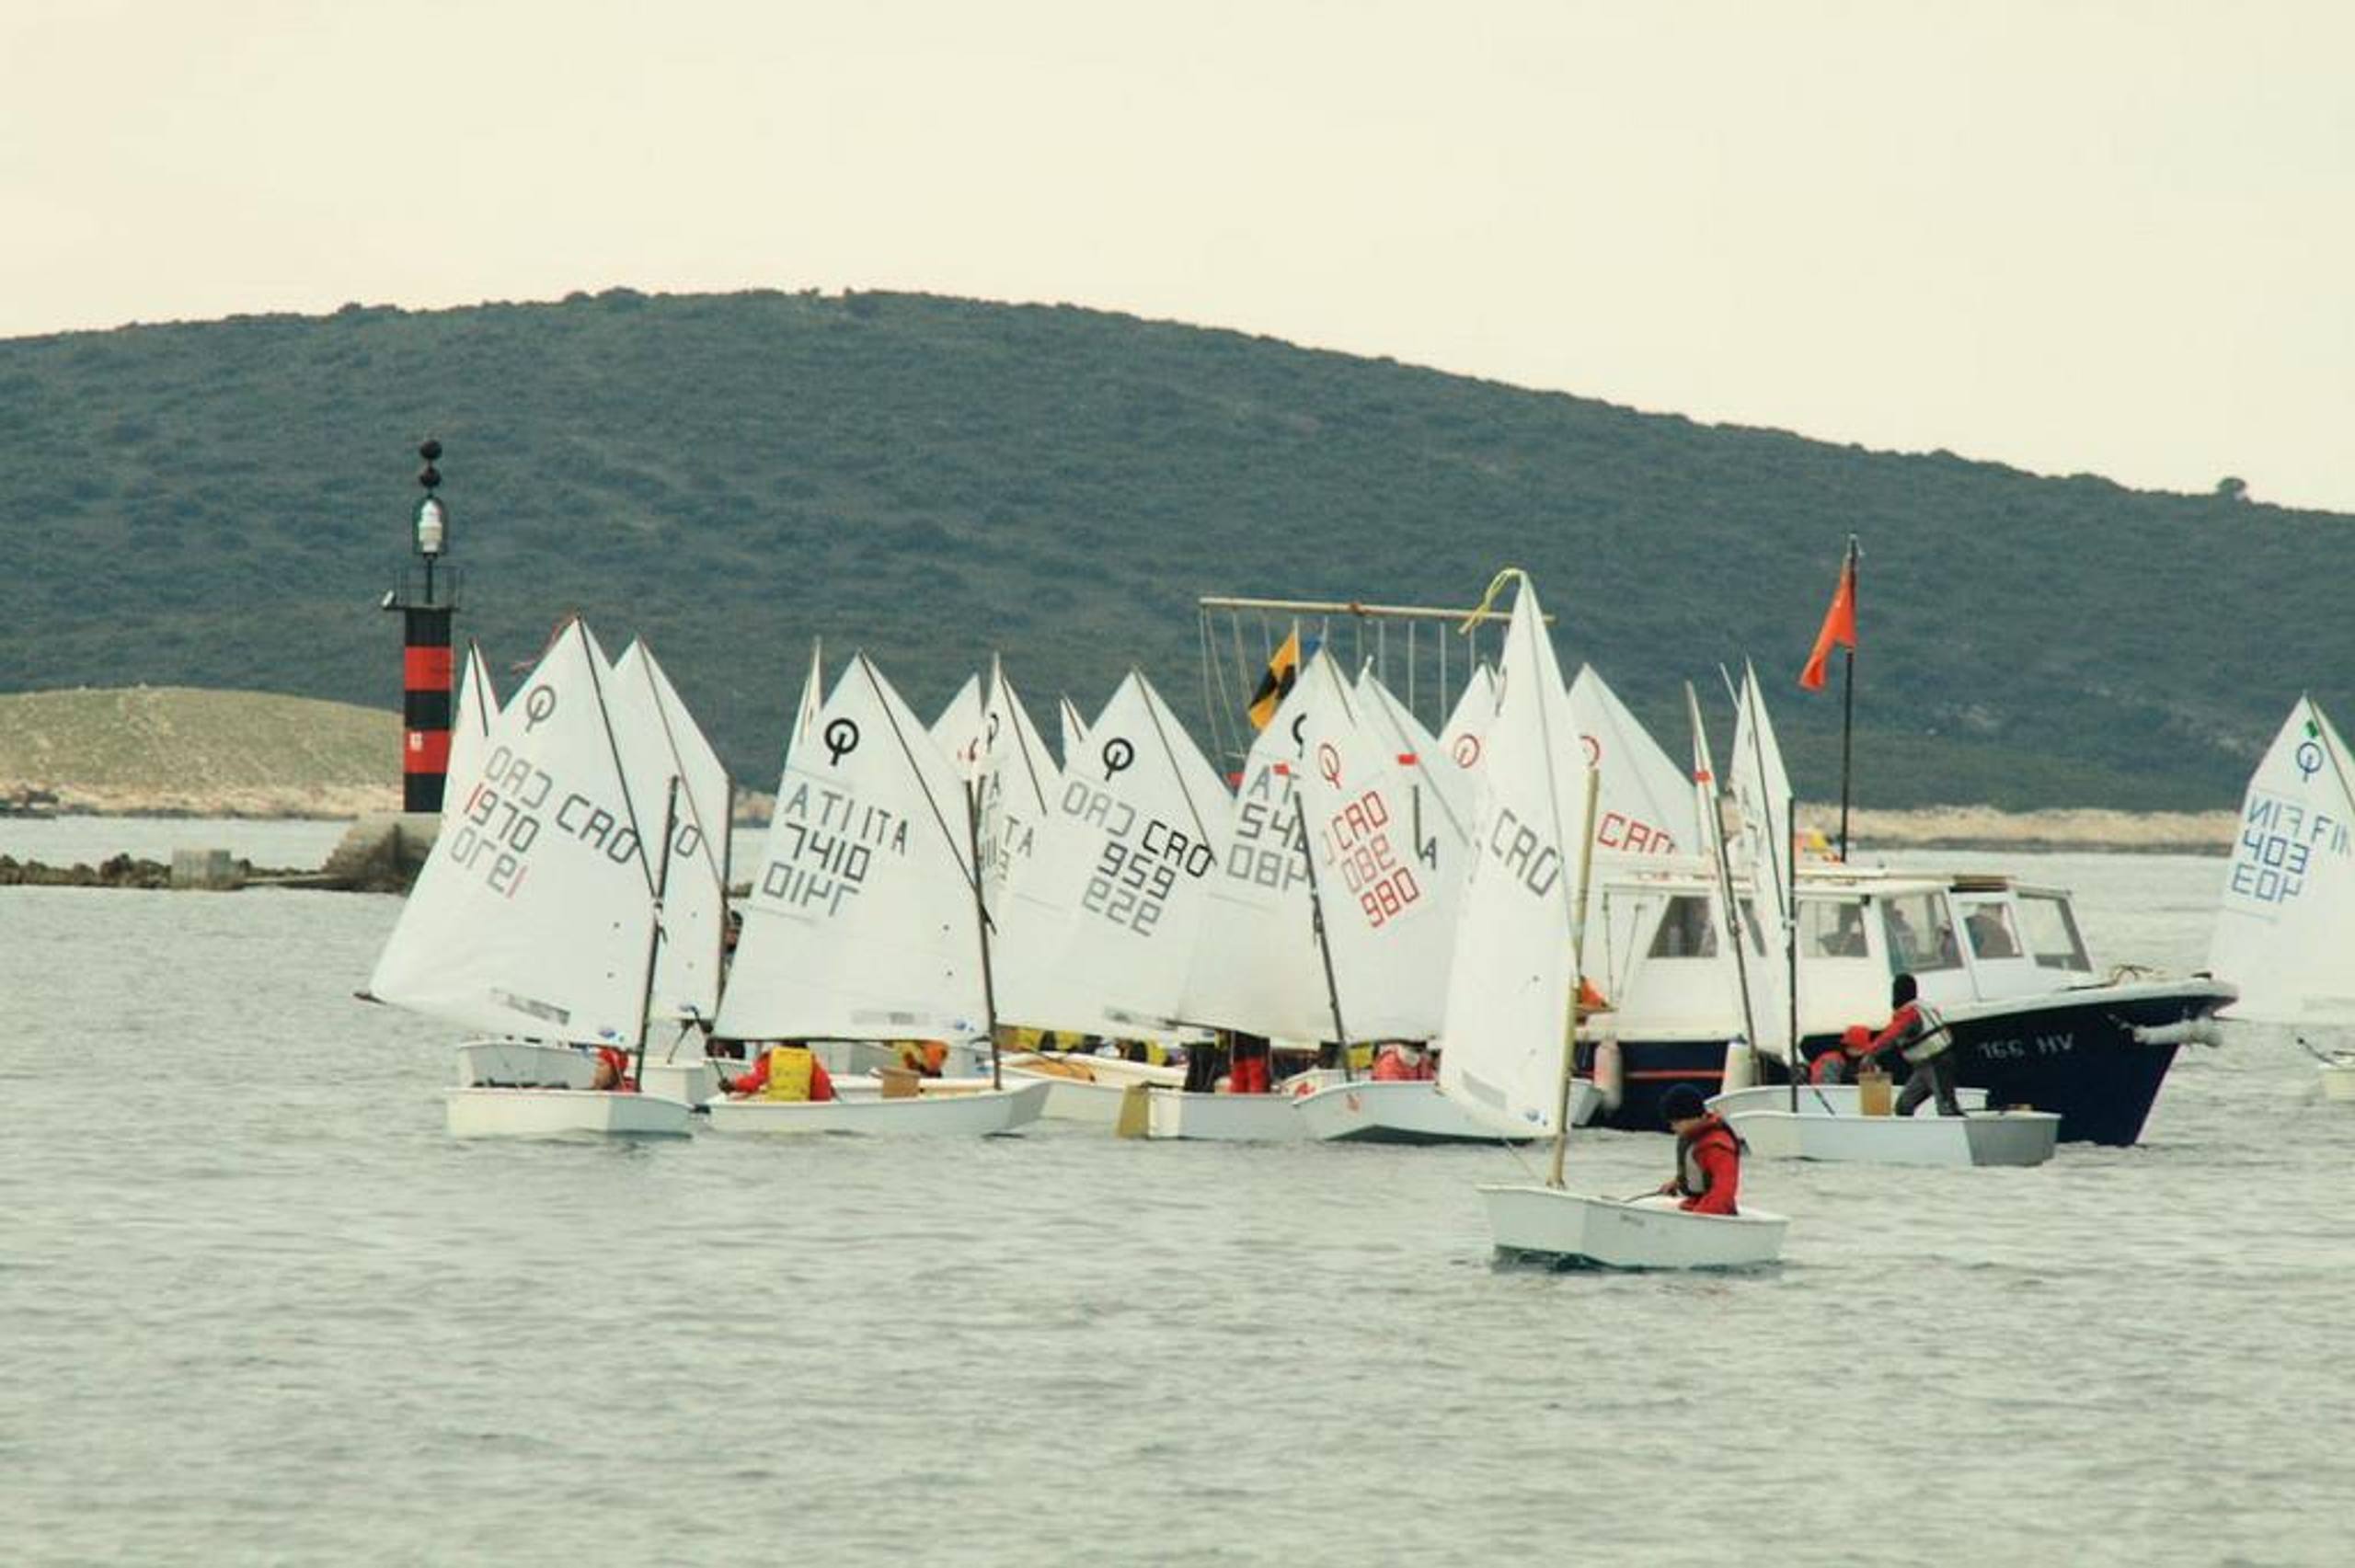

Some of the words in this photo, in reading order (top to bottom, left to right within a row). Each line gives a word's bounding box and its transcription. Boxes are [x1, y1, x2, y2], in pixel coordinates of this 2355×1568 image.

[464, 783, 541, 853] 1970
[555, 794, 640, 864] CRO
[861, 806, 908, 856] ITA
[1142, 819, 1212, 877] CRO
[1332, 791, 1388, 850] CRO
[786, 822, 871, 883] 7410
[1097, 841, 1176, 900] 959
[1490, 807, 1560, 898] CRO
[2243, 829, 2310, 875] 403
[1361, 866, 1419, 928] 980
